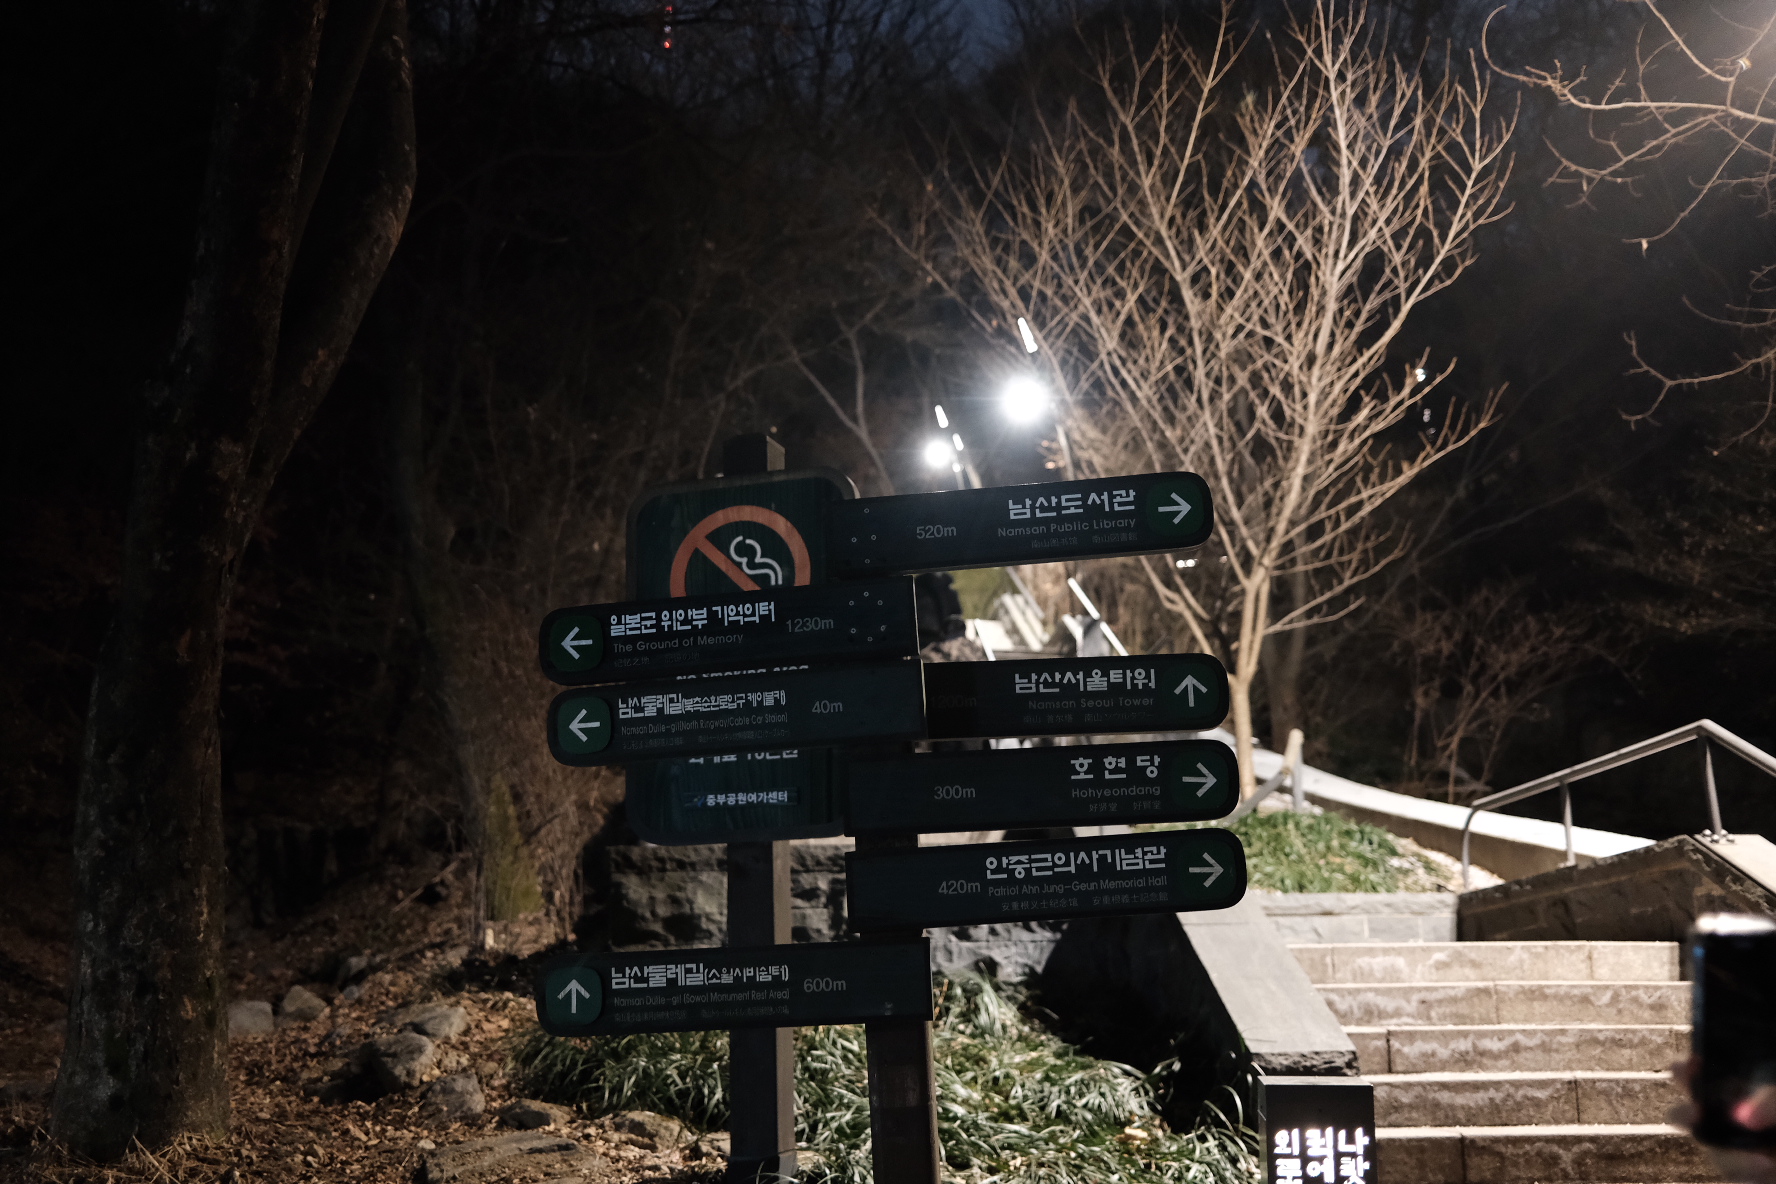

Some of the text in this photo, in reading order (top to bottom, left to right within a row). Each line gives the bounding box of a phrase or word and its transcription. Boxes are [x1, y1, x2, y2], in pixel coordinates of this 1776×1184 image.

[1008, 489, 1137, 520] 남산도서관
[916, 525, 957, 540] 520m
[998, 518, 1136, 537] Namsan Public Library
[610, 601, 776, 637] 일본군 위안부 기억의터
[786, 618, 834, 633] 1230m
[613, 633, 744, 653] The Ground of Memory
[1014, 668, 1156, 694] 남산서울타워
[811, 700, 843, 714] 40m
[1028, 697, 1154, 710] Namsan Seoul Tower
[621, 725, 647, 736] Namsan
[751, 714, 763, 724] Car
[705, 790, 788, 807] 중부공원여가센터
[933, 785, 976, 800] 300m
[1071, 785, 1161, 798] Hohyeondang
[985, 845, 1167, 879] 안중근의사기념관
[938, 880, 981, 895] 420m
[988, 875, 1167, 897] Patriot Ahn Jung-Geun Memorial Hall
[803, 977, 847, 992] 600m
[614, 996, 644, 1007] Namsan
[710, 990, 750, 1003] Monument
[751, 989, 767, 1001] Rest
